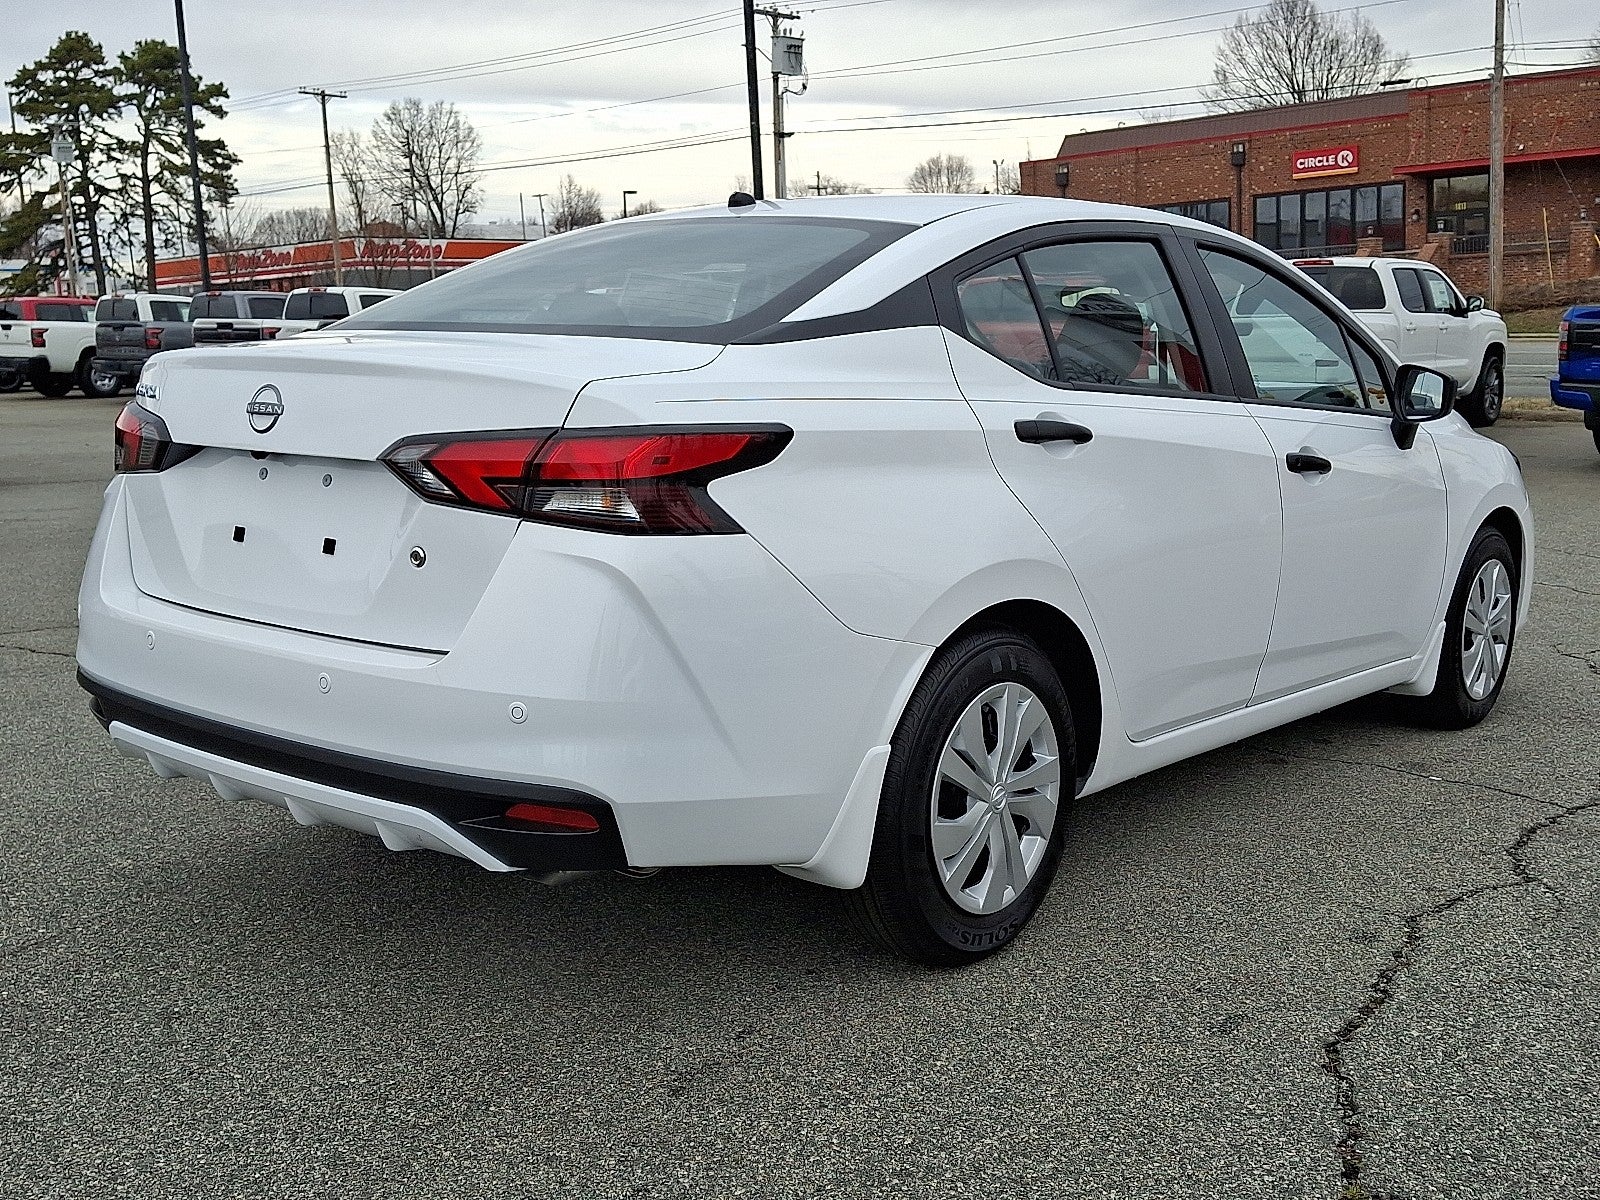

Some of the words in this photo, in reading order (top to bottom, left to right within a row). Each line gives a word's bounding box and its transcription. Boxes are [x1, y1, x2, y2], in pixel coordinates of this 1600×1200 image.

[1296, 154, 1336, 169] CIRCLE
[1339, 151, 1352, 166] K
[361, 239, 443, 259] AutoZone
[247, 403, 283, 414] NISSAN
[959, 917, 1019, 947] SOLUS
